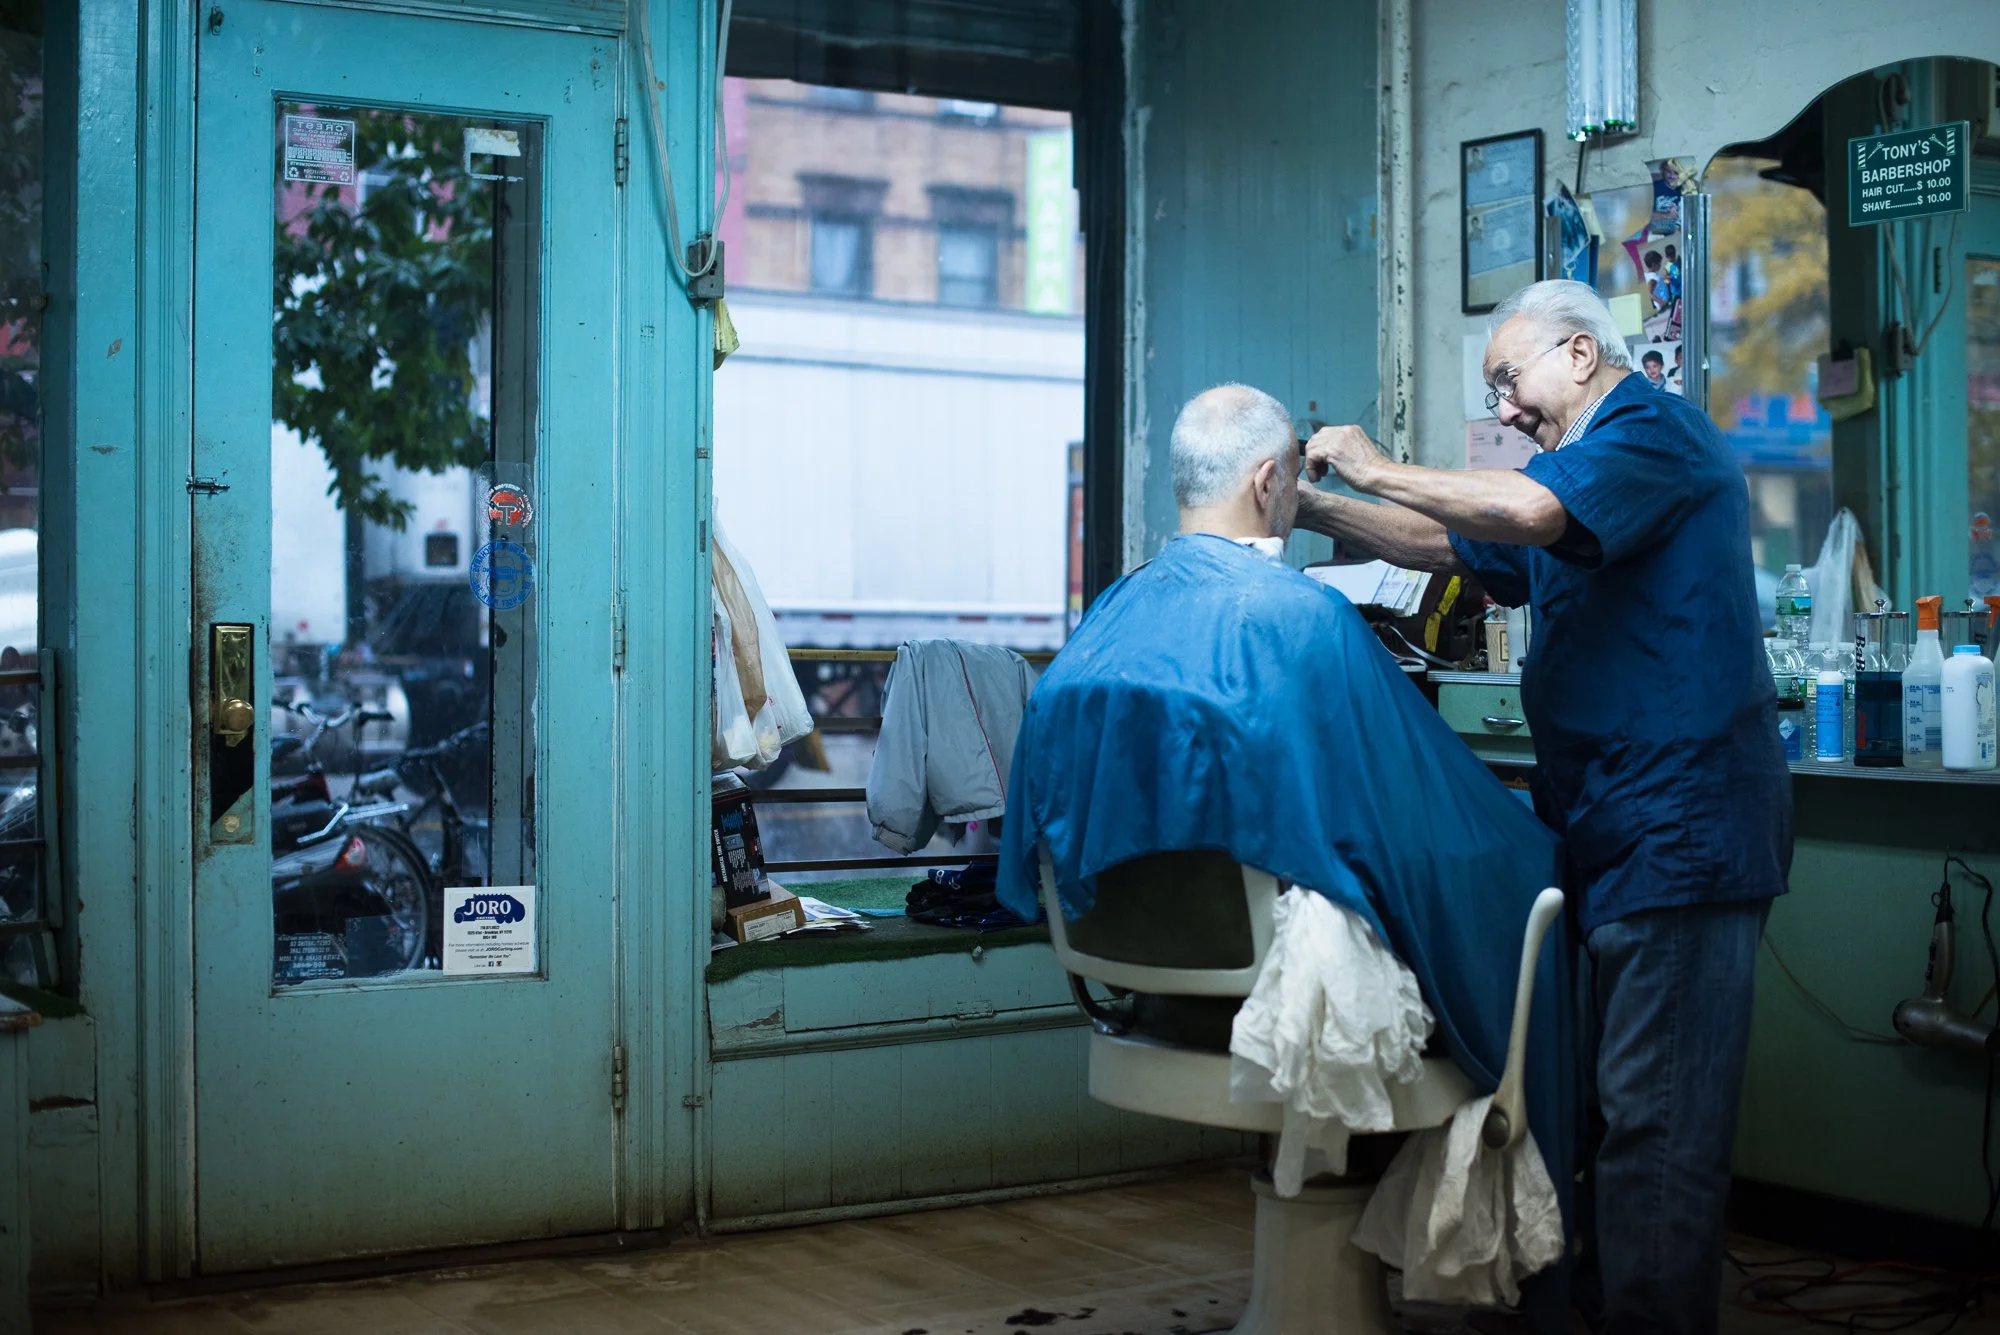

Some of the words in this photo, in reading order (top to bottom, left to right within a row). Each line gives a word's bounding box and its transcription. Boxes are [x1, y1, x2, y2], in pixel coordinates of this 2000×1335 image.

[1882, 139, 1930, 160] TONY'S
[1862, 158, 1951, 184] BARBERSHOP
[1862, 186, 1883, 198] HAIR
[1926, 177, 1951, 188] 10.00
[1927, 191, 1952, 204] 10.00
[464, 900, 511, 916] JORO
